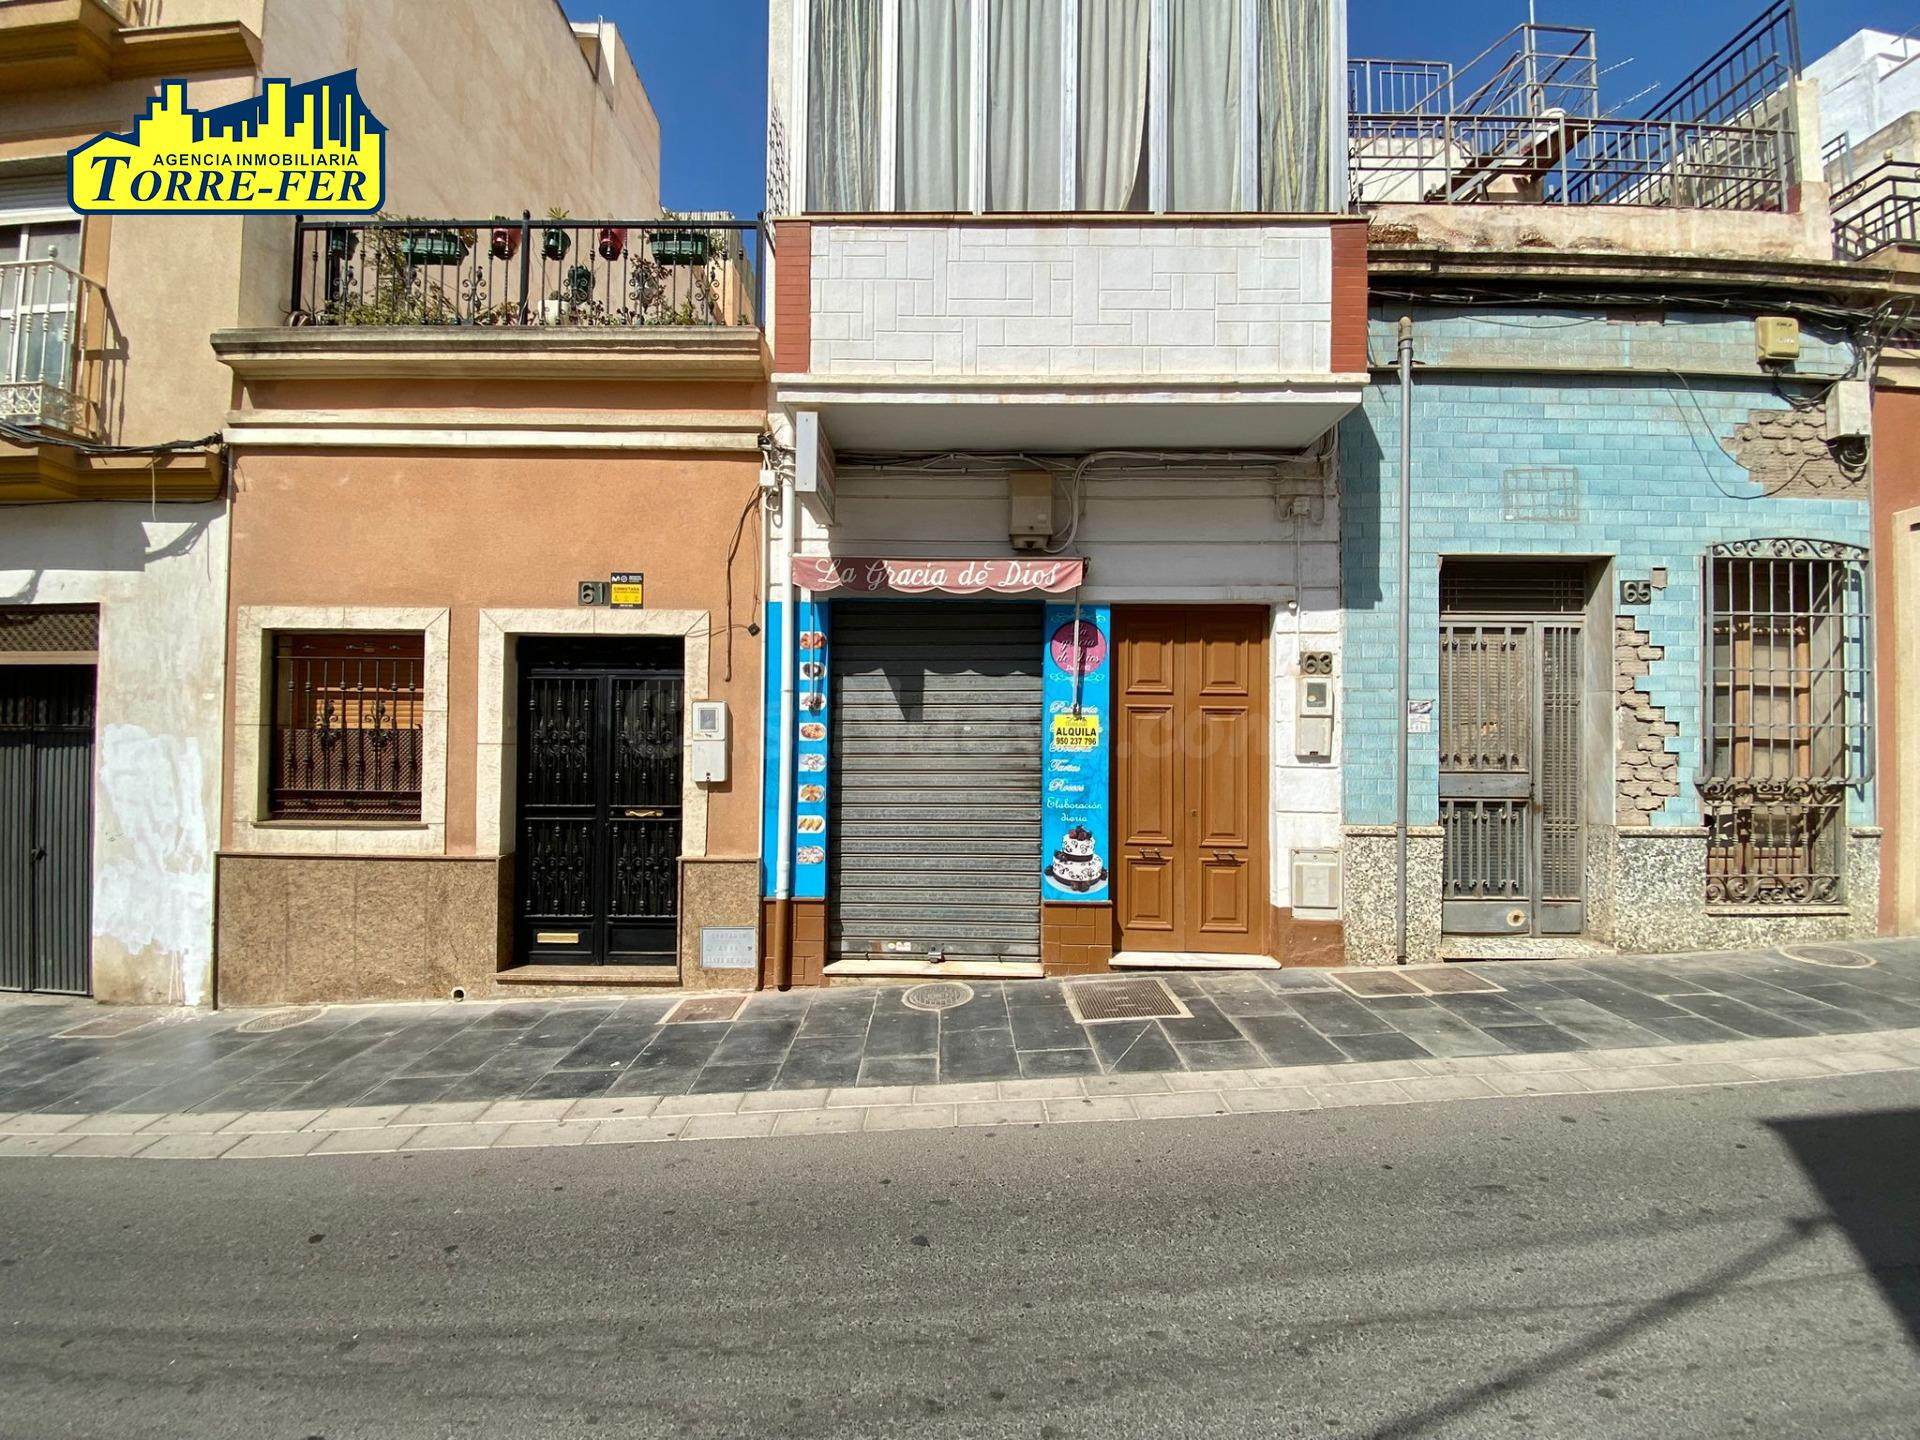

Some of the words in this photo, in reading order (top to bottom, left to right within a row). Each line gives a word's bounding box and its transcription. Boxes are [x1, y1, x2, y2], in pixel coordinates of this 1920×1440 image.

[815, 559, 857, 586] La
[866, 559, 947, 592] Gracia
[988, 560, 1061, 588] Dios
[580, 582, 606, 604] 61
[1623, 581, 1651, 603] 65
[1302, 652, 1332, 675] 63
[1055, 737, 1069, 745] 950
[1070, 737, 1082, 745] 237
[1084, 737, 1097, 746] 796
[1056, 727, 1097, 737] ALQUILA
[1047, 797, 1102, 809] Elaboración
